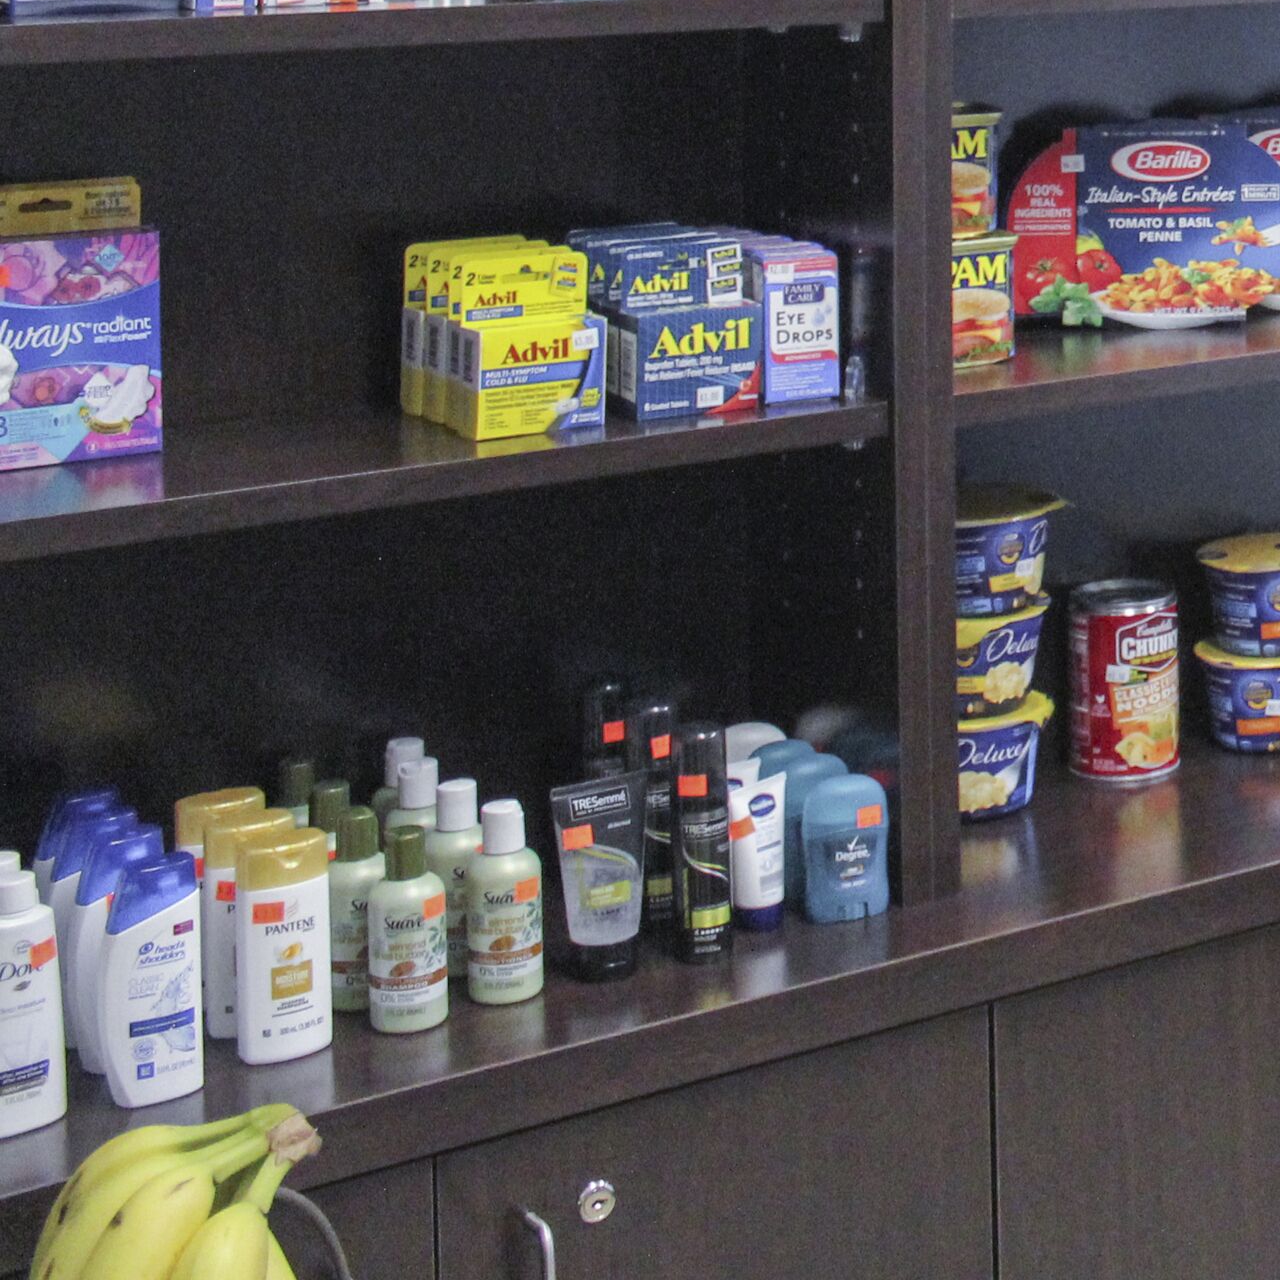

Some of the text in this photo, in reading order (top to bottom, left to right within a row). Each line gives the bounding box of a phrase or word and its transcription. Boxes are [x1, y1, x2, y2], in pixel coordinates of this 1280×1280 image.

[1134, 149, 1203, 172] Barilla
[1025, 184, 1063, 197] 100%
[1030, 198, 1056, 208] REAL
[1014, 207, 1072, 219] INGREDIENTS
[1108, 217, 1163, 230] TOMATO
[1178, 216, 1214, 229] BASIL
[1139, 230, 1182, 243] PENNE
[629, 271, 690, 296] Advil
[474, 291, 518, 308] Advil
[93, 314, 151, 336] radiant
[776, 310, 806, 326] EYE
[648, 318, 751, 359] Advil
[776, 329, 833, 345] DROPS
[501, 336, 569, 366] Advil
[265, 917, 315, 936] PANTENE
